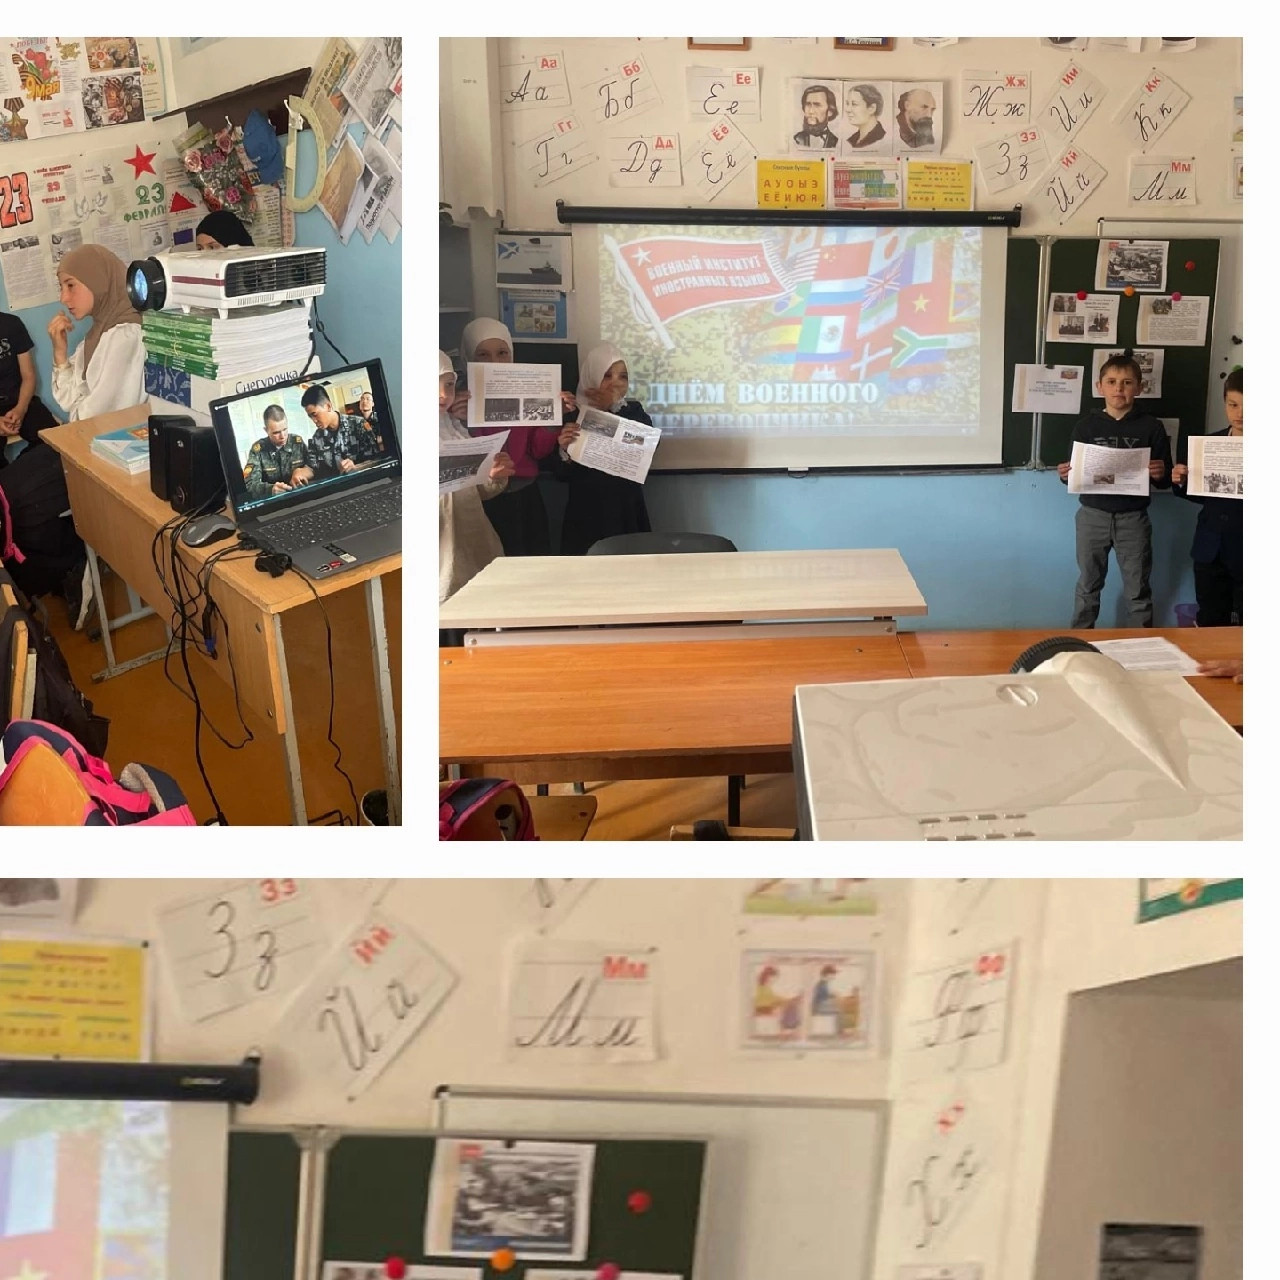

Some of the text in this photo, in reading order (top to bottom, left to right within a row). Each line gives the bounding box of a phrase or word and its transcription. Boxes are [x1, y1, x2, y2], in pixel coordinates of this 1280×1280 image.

[541, 58, 557, 69] Аа
[623, 61, 641, 76] Бб
[736, 73, 751, 85] Ее
[1006, 76, 1026, 87] Жж
[26, 76, 36, 99] 9
[558, 120, 573, 132] Гг
[655, 137, 673, 149] Дд
[1020, 131, 1037, 142] Зз
[1172, 162, 1191, 172] Мм
[135, 182, 165, 206] 23
[123, 205, 166, 222] ФЕВРАЛ
[647, 255, 761, 280] ВОЕННЫЙ ИНСТИТУТ
[652, 272, 771, 297] ИНОСТРАННЫХ ЯЗЫКОВ
[235, 370, 299, 394] Снегурочка
[647, 379, 879, 406] ДНЁМ ВОЕННОГО
